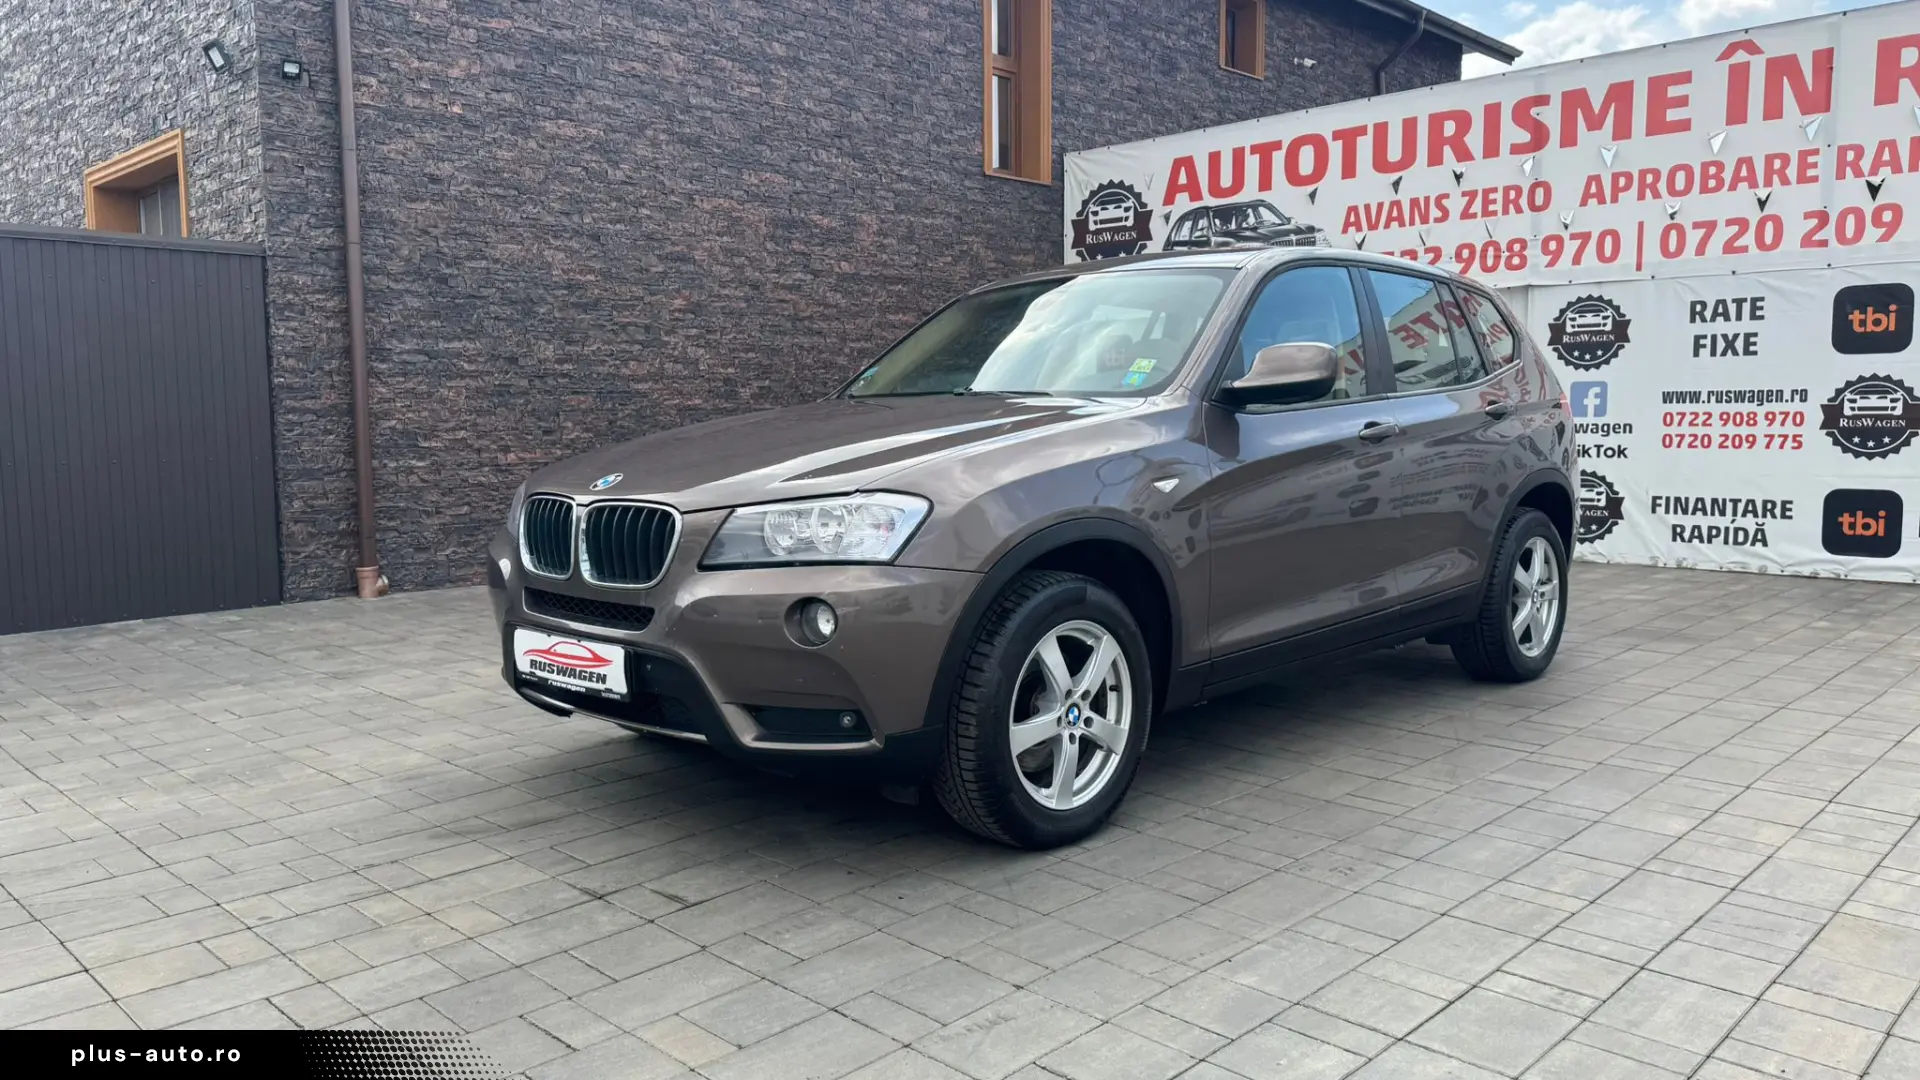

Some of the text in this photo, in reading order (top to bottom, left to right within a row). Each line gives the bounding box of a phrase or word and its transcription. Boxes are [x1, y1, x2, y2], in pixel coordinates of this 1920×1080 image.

[1162, 70, 1693, 207] AUTOTURISME
[1715, 38, 1835, 126] ÎN
[1341, 192, 1451, 235] AVANS
[1459, 179, 1553, 221] ZERO
[1579, 147, 1821, 207] APROBARE
[1454, 237, 1529, 276] 908
[1540, 229, 1622, 268] 970
[1659, 213, 1784, 260] 0720
[1800, 202, 1904, 249] 209
[1689, 296, 1766, 324] RATE
[1848, 304, 1898, 333] tbi
[1692, 332, 1759, 358] FIXE
[1661, 388, 1809, 407] www.ruswagen.ro
[1574, 422, 1633, 437] wagen
[1662, 410, 1806, 428] 0722 908 970
[1576, 443, 1629, 459] ikTok
[1661, 433, 1804, 450] 0720 209 775
[1671, 521, 1769, 548] RAPIDĂ
[1838, 510, 1887, 537] tbi
[529, 658, 608, 685] RUSWAGEN
